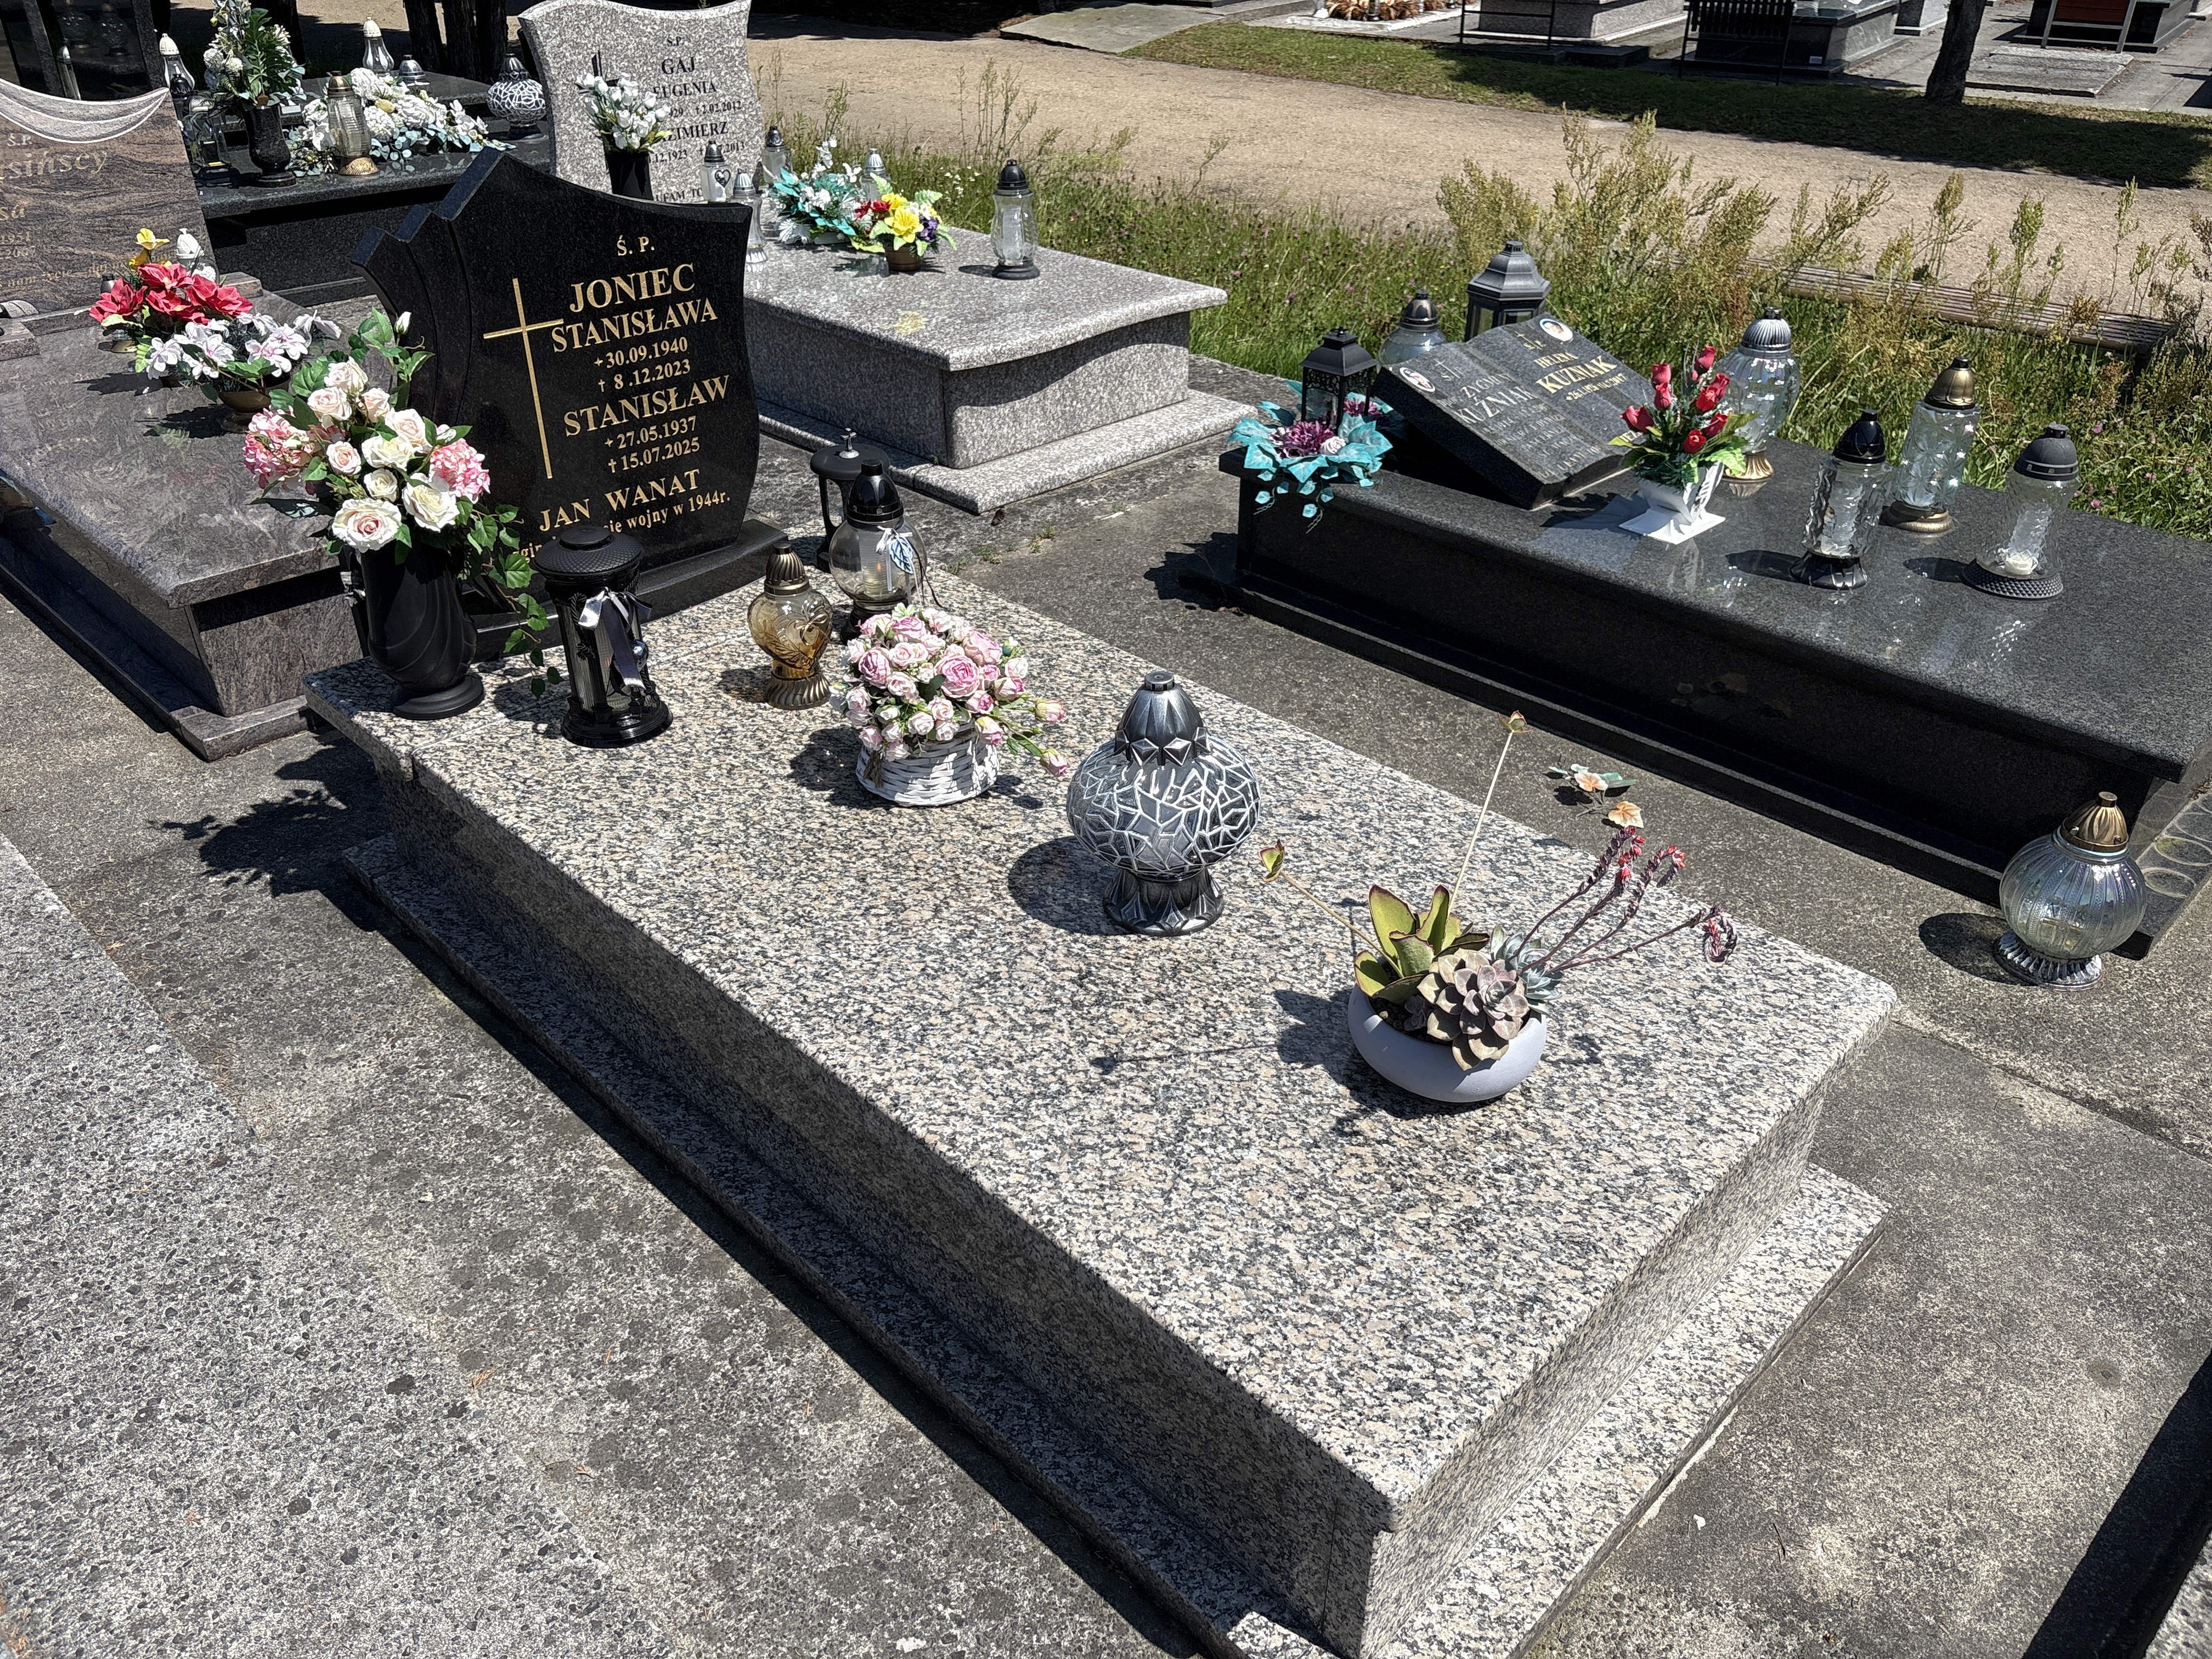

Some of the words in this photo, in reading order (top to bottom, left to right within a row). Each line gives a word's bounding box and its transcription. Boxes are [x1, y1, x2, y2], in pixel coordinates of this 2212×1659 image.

[662, 57, 695, 75] GAJ
[653, 81, 717, 99] EUGENIA
[662, 121, 729, 142] ZIMIERZ
[0, 150, 108, 179] sińscy
[616, 234, 633, 256] Ś.
[637, 236, 655, 252] P.
[569, 262, 695, 313] JONIEC
[551, 297, 719, 353] STANISŁAWA
[605, 336, 688, 369] 30.09.1940
[1534, 352, 1579, 369] HELENA
[1536, 355, 1618, 394] KUŹNIAK
[563, 375, 730, 437] STANISŁAW
[1454, 385, 1538, 424] KUŹNIAK
[617, 415, 696, 449] 27.05.1937
[620, 436, 700, 471] 15.07.2025
[539, 498, 591, 532] JAN
[605, 468, 700, 511] WANAT
[626, 507, 668, 528] wojny
[673, 503, 684, 516] w
[688, 490, 730, 512] 1944r.
